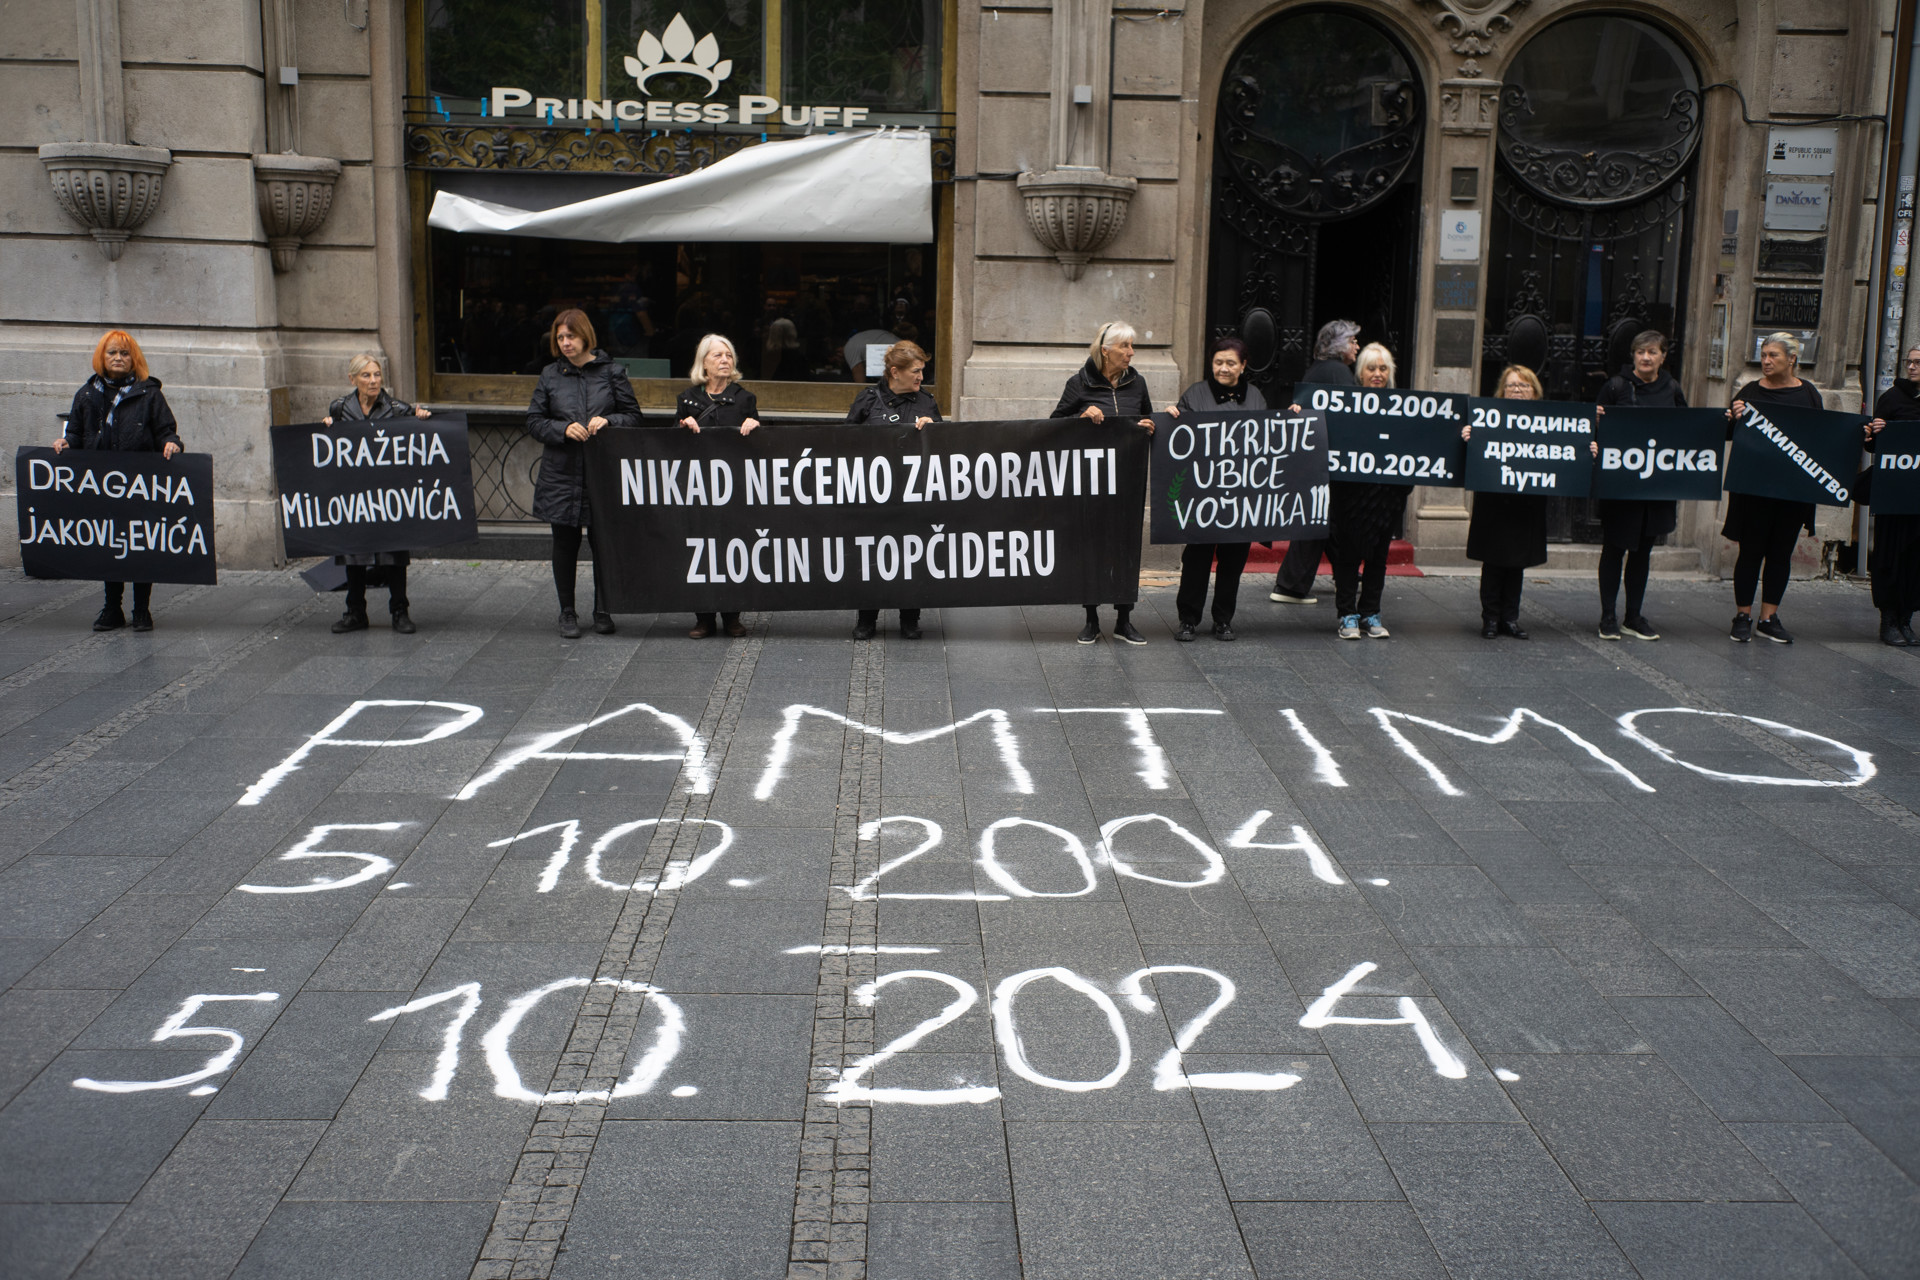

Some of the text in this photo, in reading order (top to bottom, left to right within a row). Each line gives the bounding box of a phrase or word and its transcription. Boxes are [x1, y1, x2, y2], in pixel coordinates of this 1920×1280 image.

[492, 87, 869, 127] PRINCESS PUFF
[1788, 146, 1832, 155] REPUBLIC SQUARE
[1459, 177, 1470, 194] 7
[1775, 292, 1819, 306] NEKRETNINE
[1311, 389, 1461, 421] 05.10.2004.
[1471, 407, 1592, 435] 20 година
[1168, 411, 1319, 461] OTKRIJTE
[1483, 440, 1576, 463] држава
[1741, 401, 1849, 502] тужилаштво
[620, 447, 1117, 506] NIKAD NEĆEMO ZABORAVITI
[1192, 453, 1290, 490] UBICE
[1327, 451, 1454, 480] 5.10.2024.
[1601, 439, 1718, 480] војска
[685, 523, 1055, 584] ZLOČIN U TOPČIDERU
[237, 700, 1877, 806] PAMTIMO
[237, 809, 1390, 902] 5. 10. 2004.
[73, 961, 1520, 1108] 5. 10. 2024.
